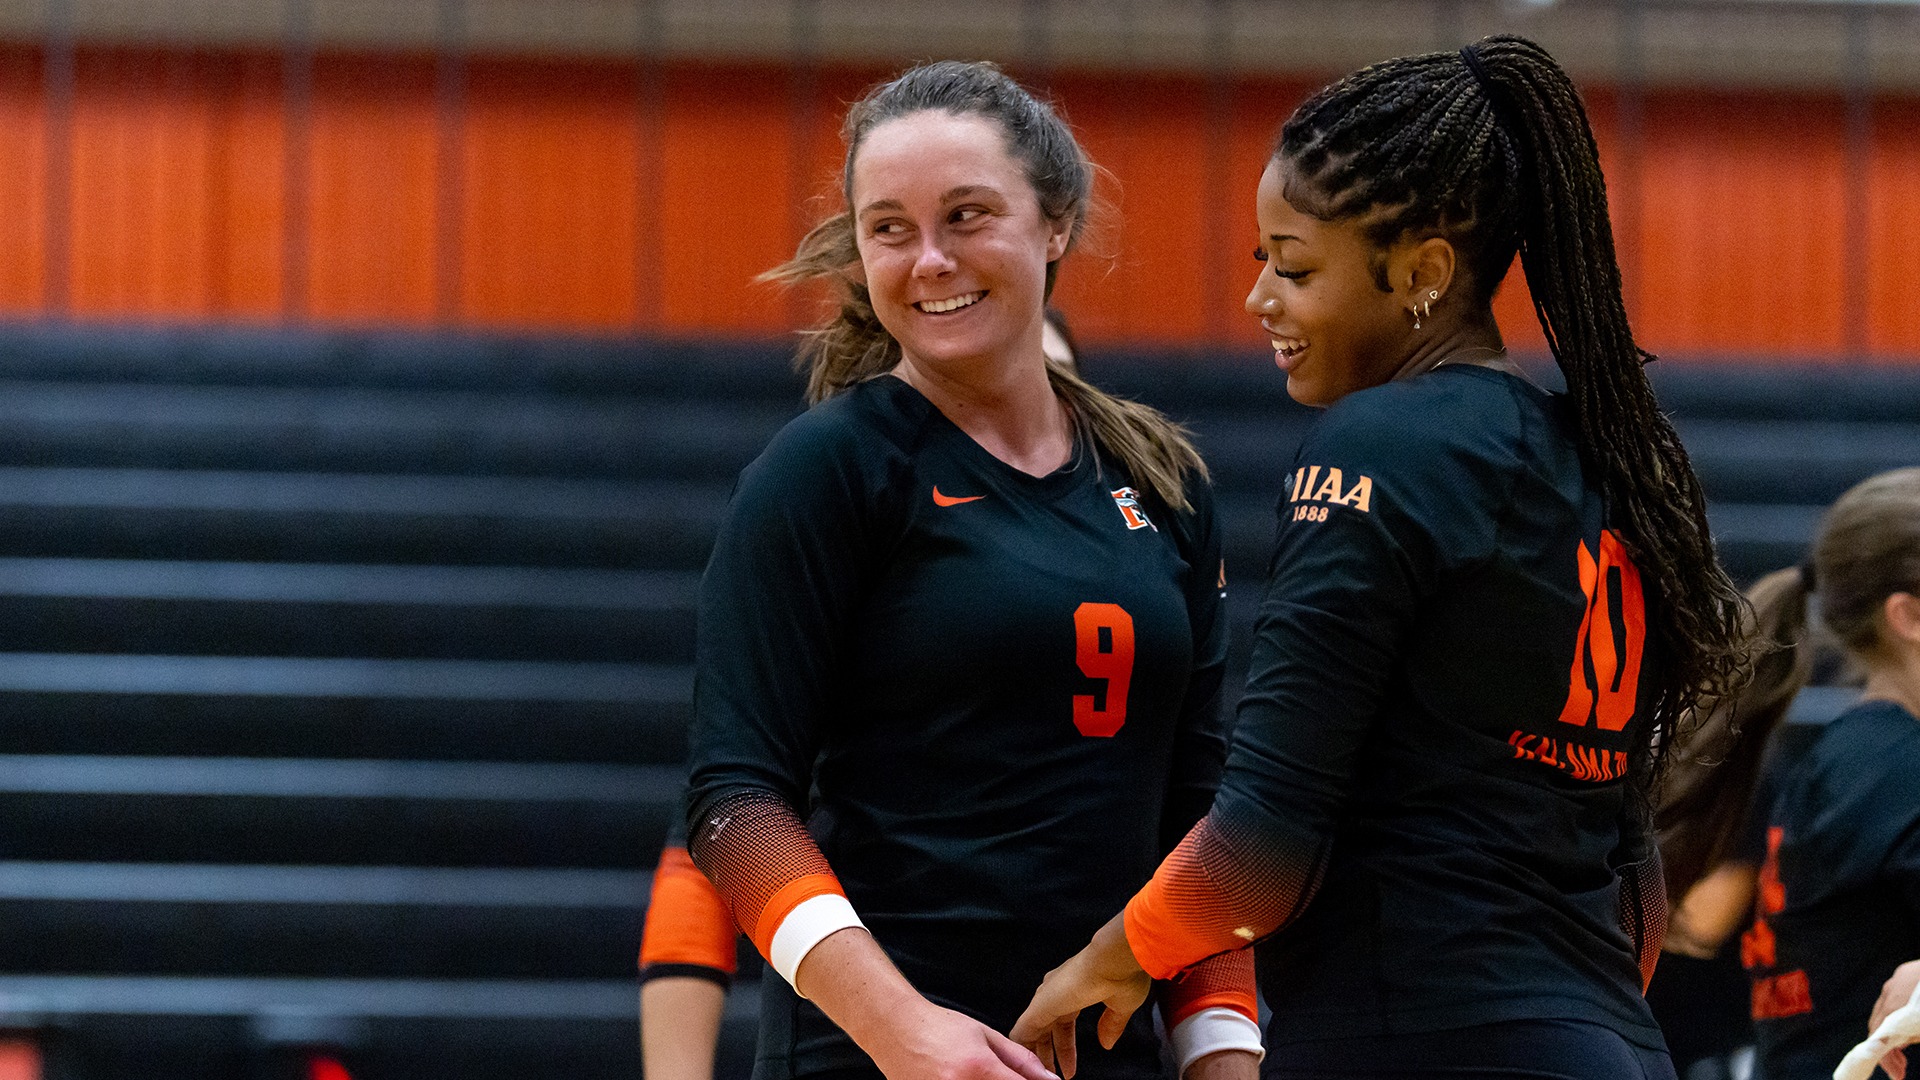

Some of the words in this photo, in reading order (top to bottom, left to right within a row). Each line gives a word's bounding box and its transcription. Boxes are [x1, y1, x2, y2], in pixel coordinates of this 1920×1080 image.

[1292, 505, 1329, 522] 1888
[1073, 602, 1135, 738] 9
[1558, 529, 1646, 731] 10
